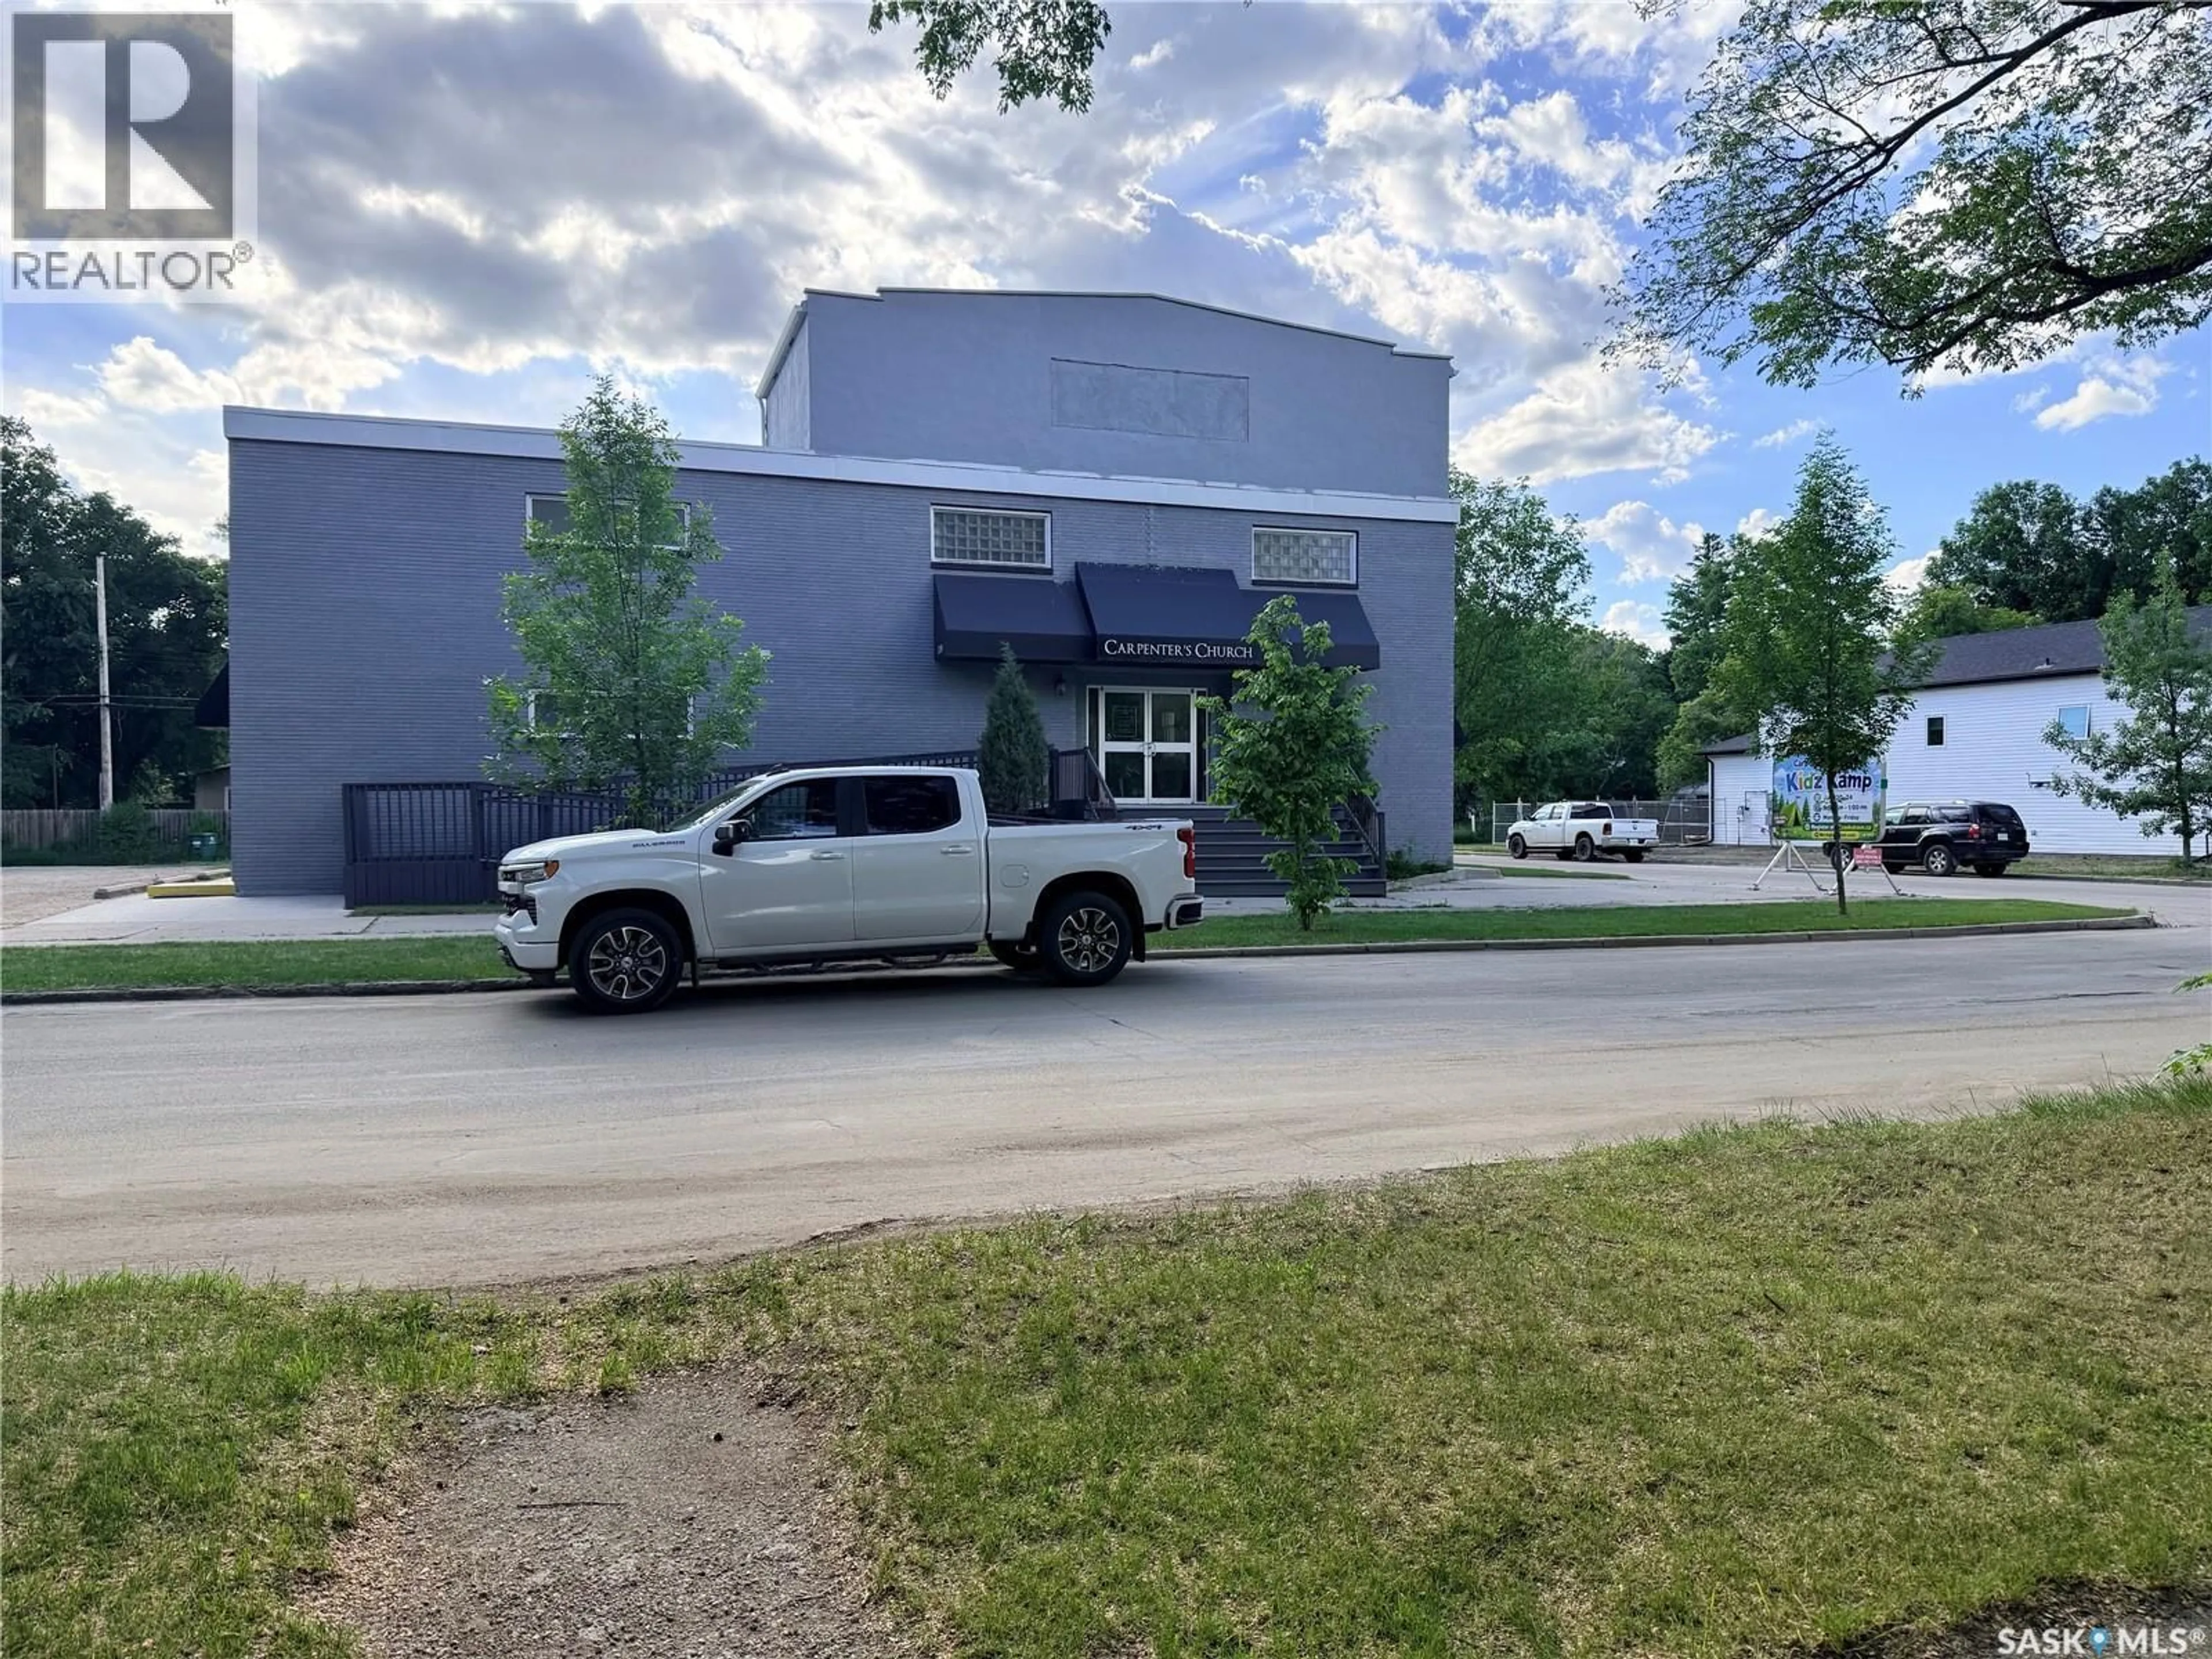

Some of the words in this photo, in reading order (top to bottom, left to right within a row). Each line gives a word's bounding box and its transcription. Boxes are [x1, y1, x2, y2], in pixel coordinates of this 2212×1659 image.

[1104, 639, 1192, 657] CARPENTER'S
[1195, 643, 1253, 658] CHURCH
[1787, 771, 1823, 792] Kidz
